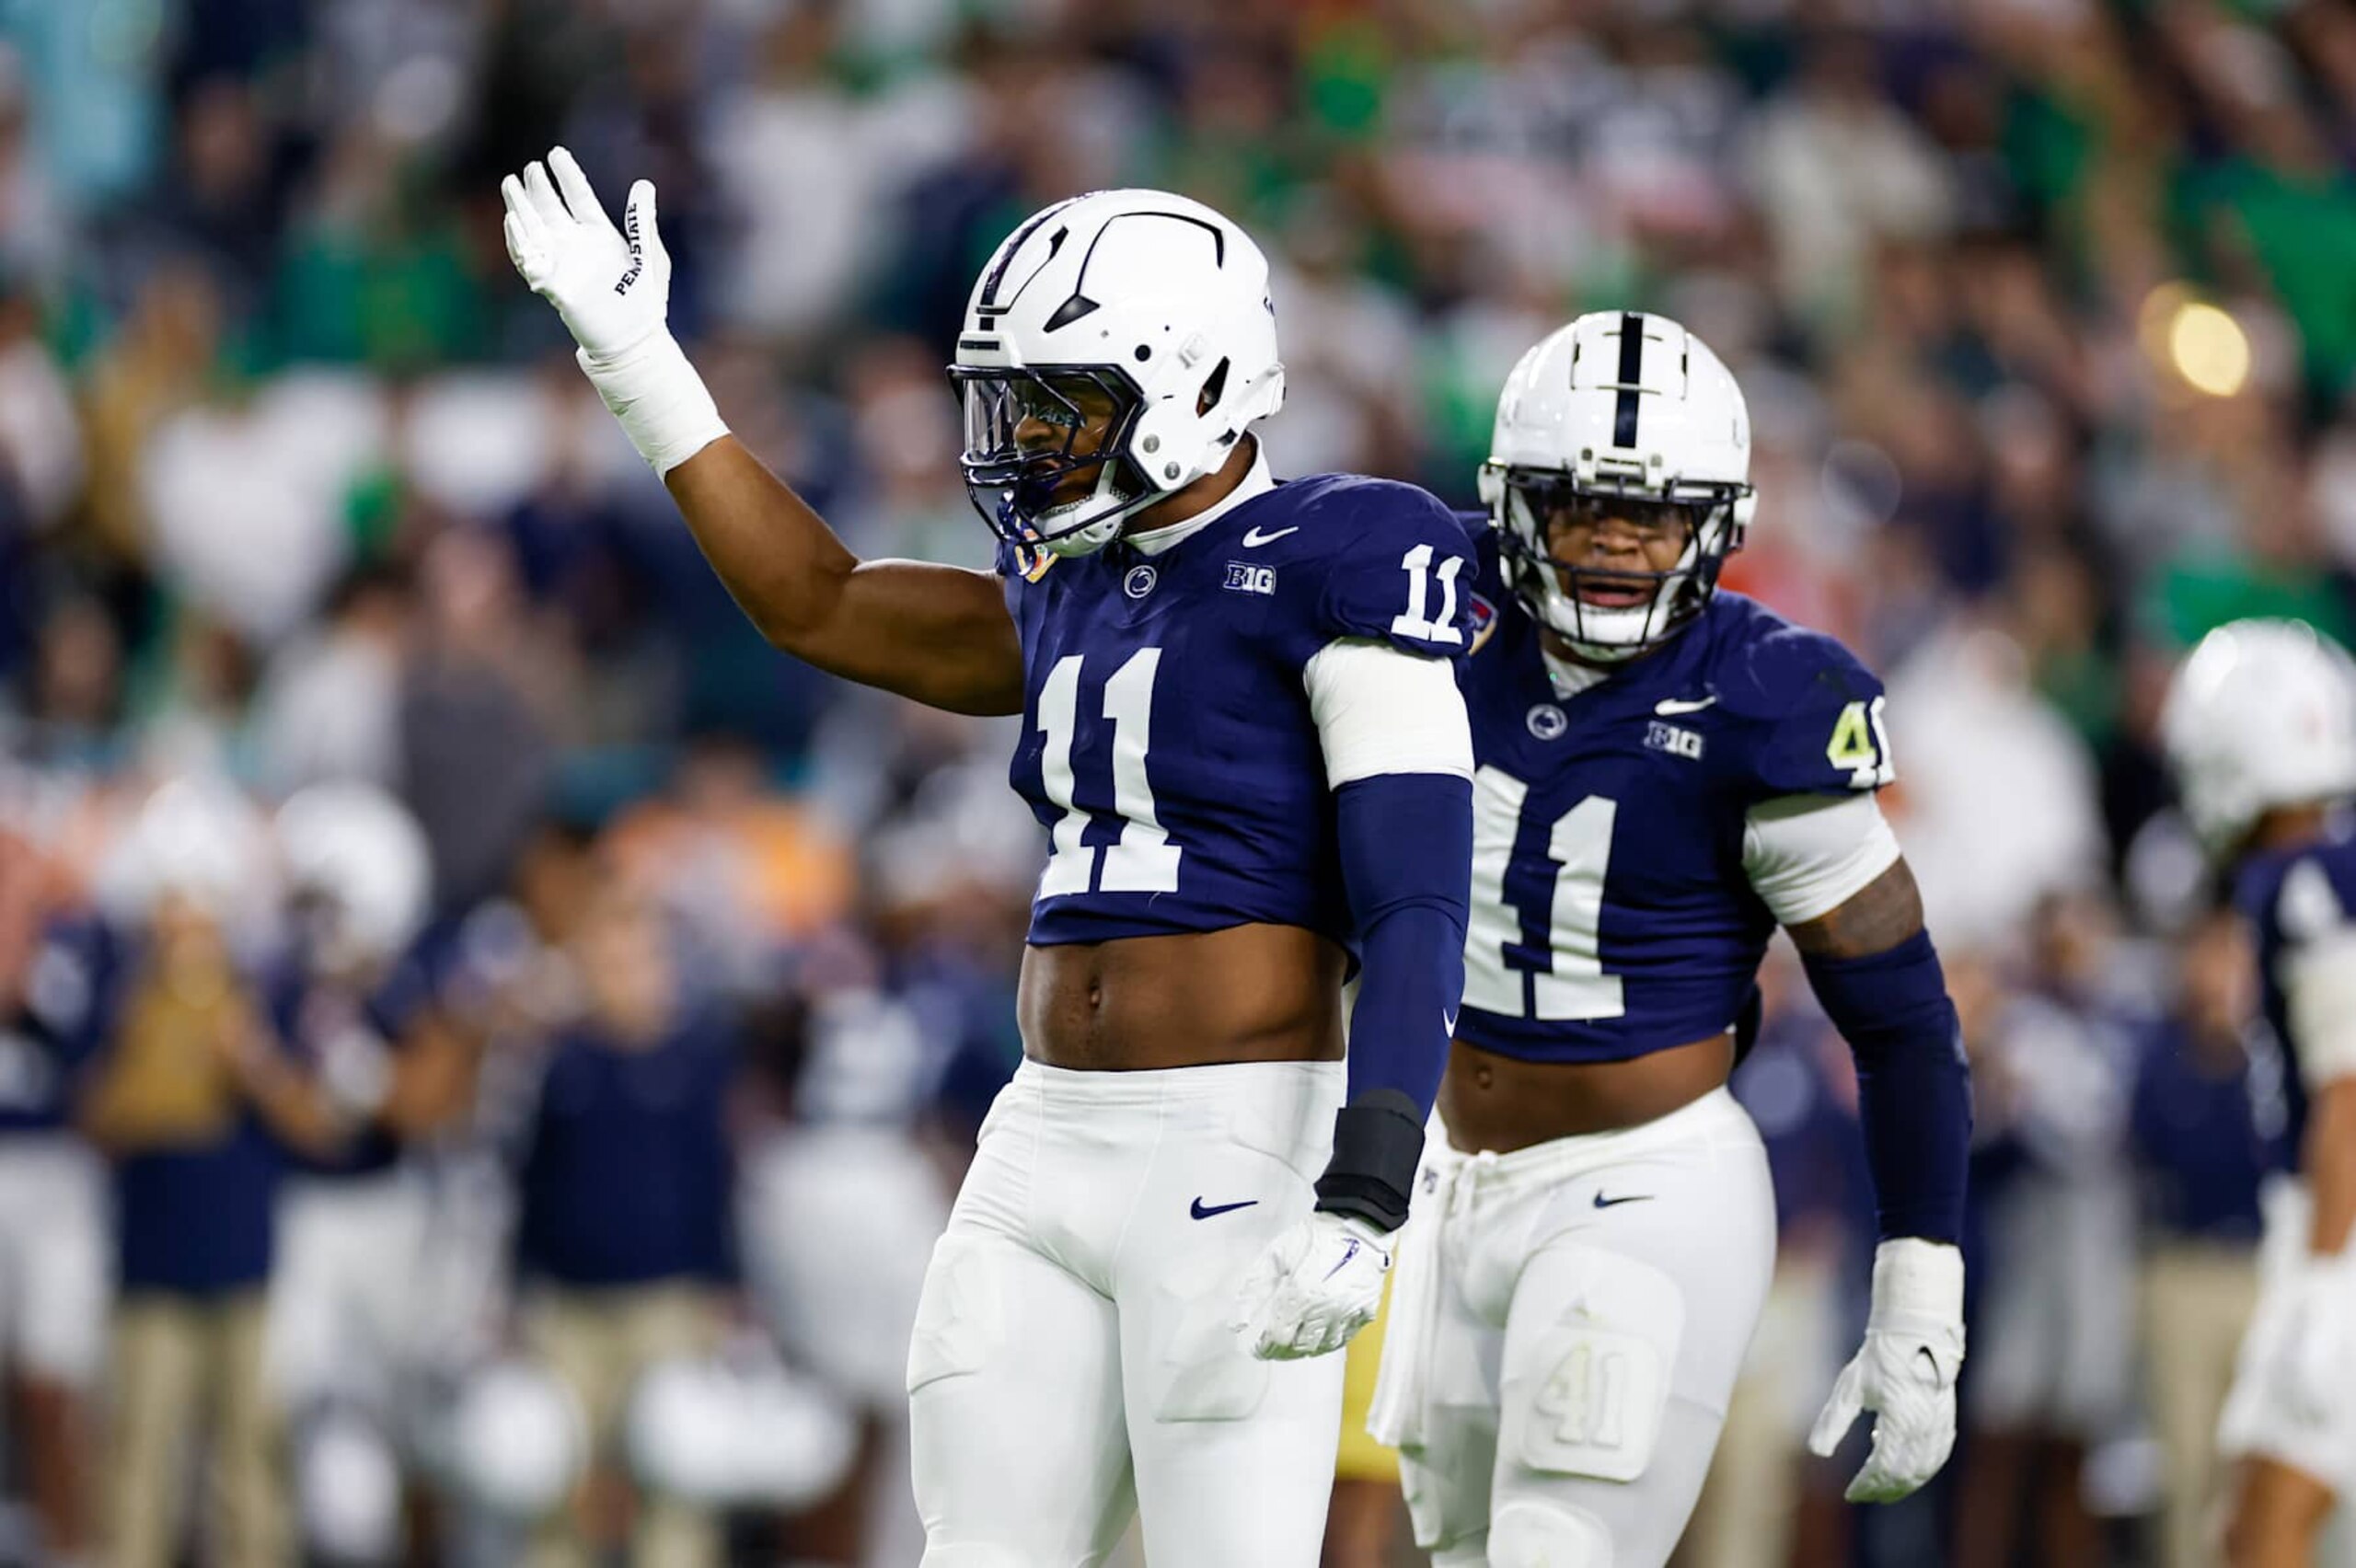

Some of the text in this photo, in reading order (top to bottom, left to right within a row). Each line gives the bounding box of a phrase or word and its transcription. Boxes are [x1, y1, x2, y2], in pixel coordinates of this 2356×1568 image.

[615, 203, 643, 296] PENN STATE
[1392, 544, 1465, 644] 11
[1037, 647, 1183, 901] 11
[1826, 696, 1896, 789] 41
